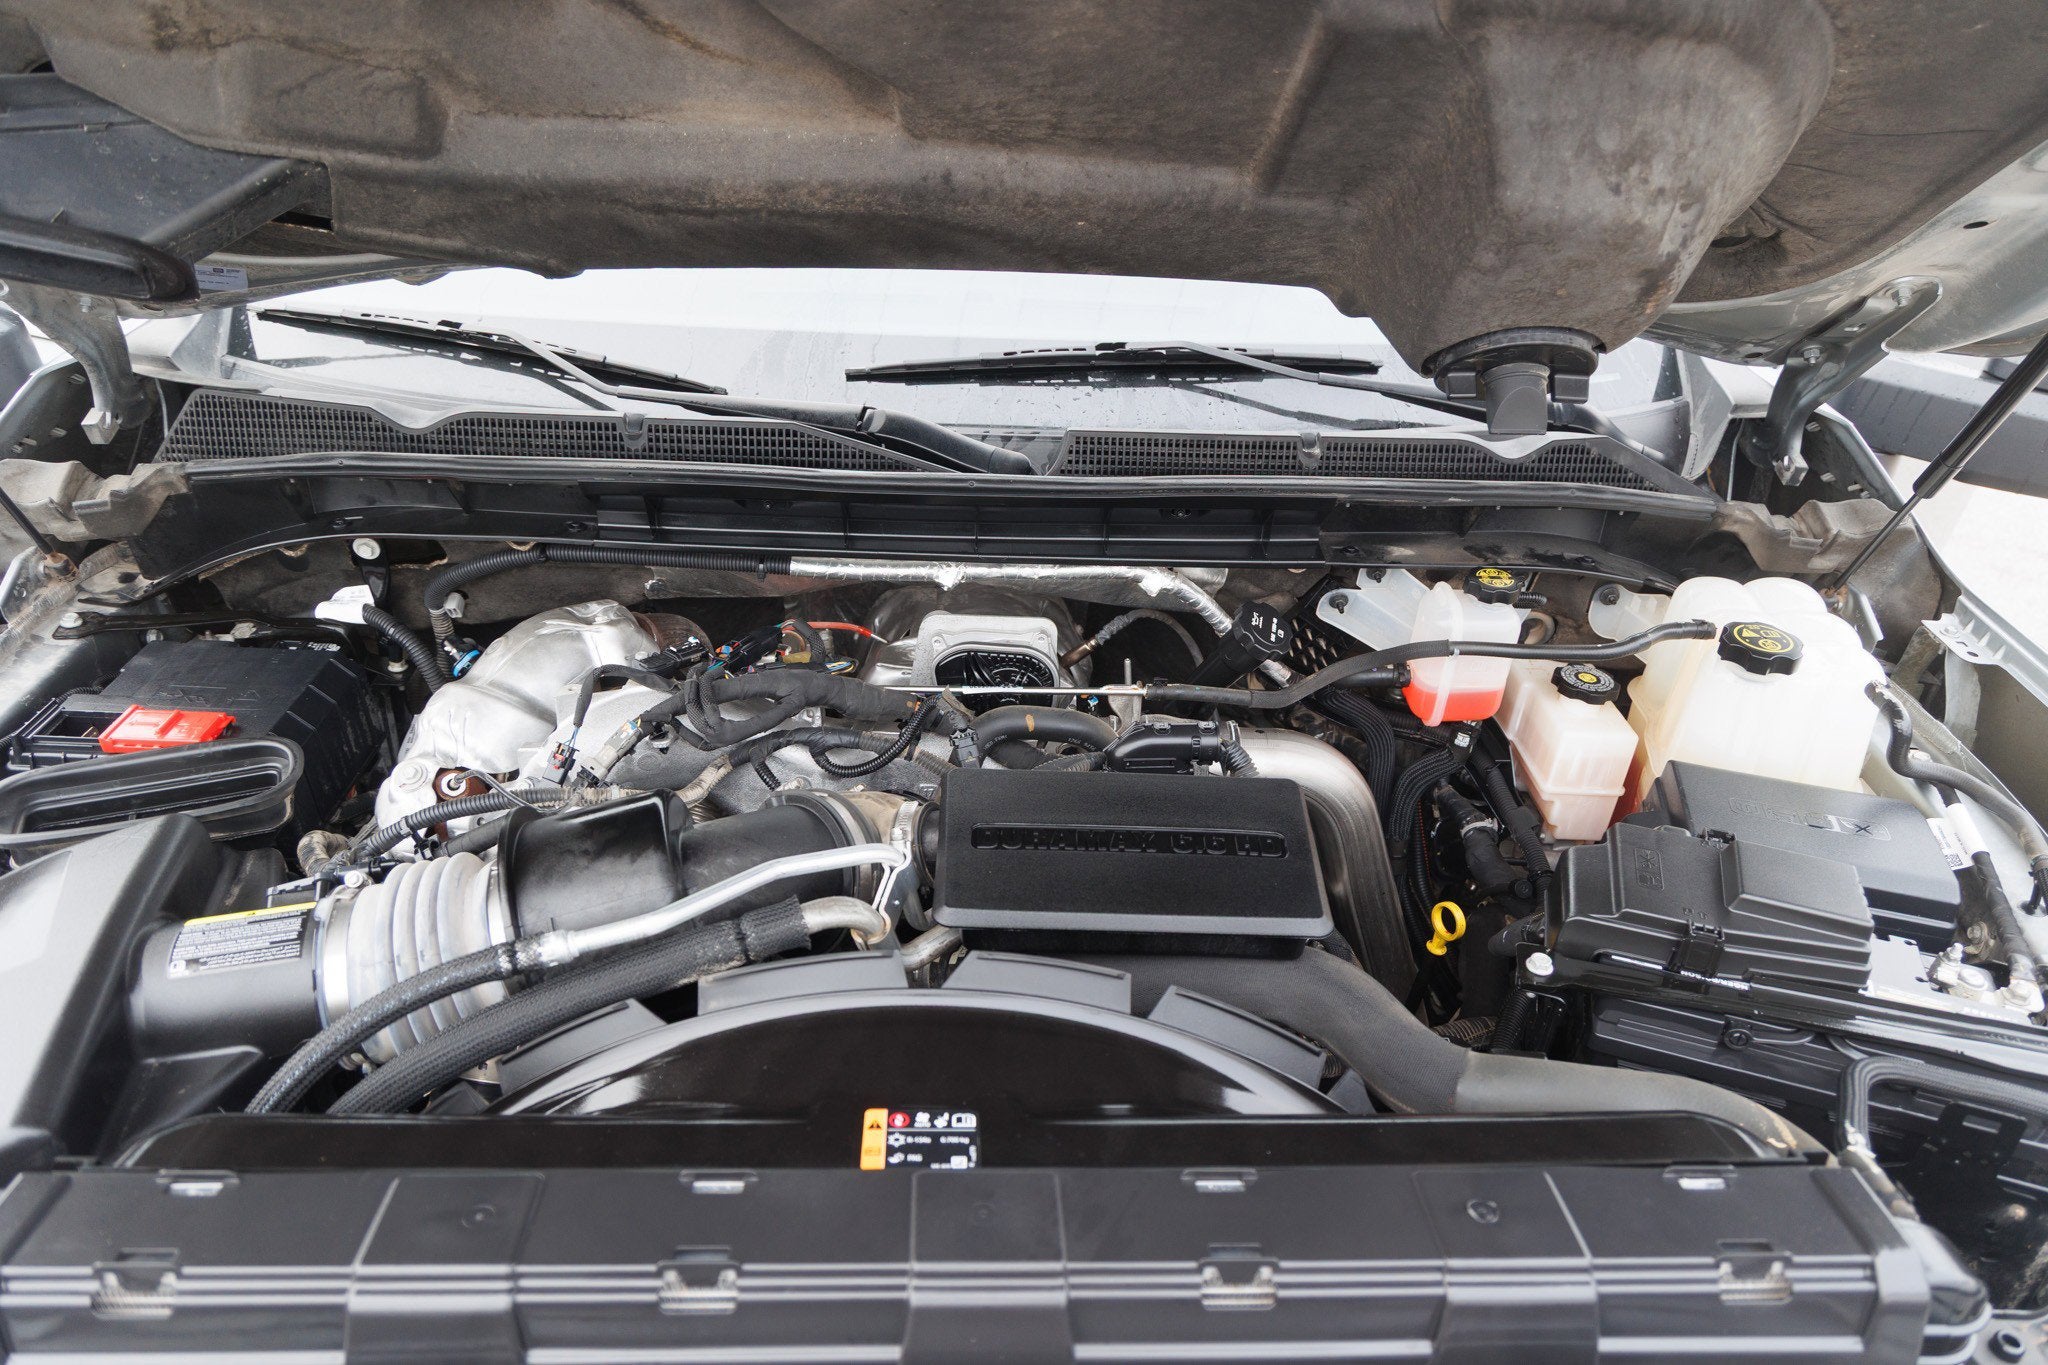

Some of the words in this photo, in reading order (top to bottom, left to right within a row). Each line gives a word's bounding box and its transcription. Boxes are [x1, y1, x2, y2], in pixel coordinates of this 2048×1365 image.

[975, 828, 1157, 853] DURAMAX
[1169, 833, 1228, 855] 6.6
[1234, 834, 1283, 858] HD
